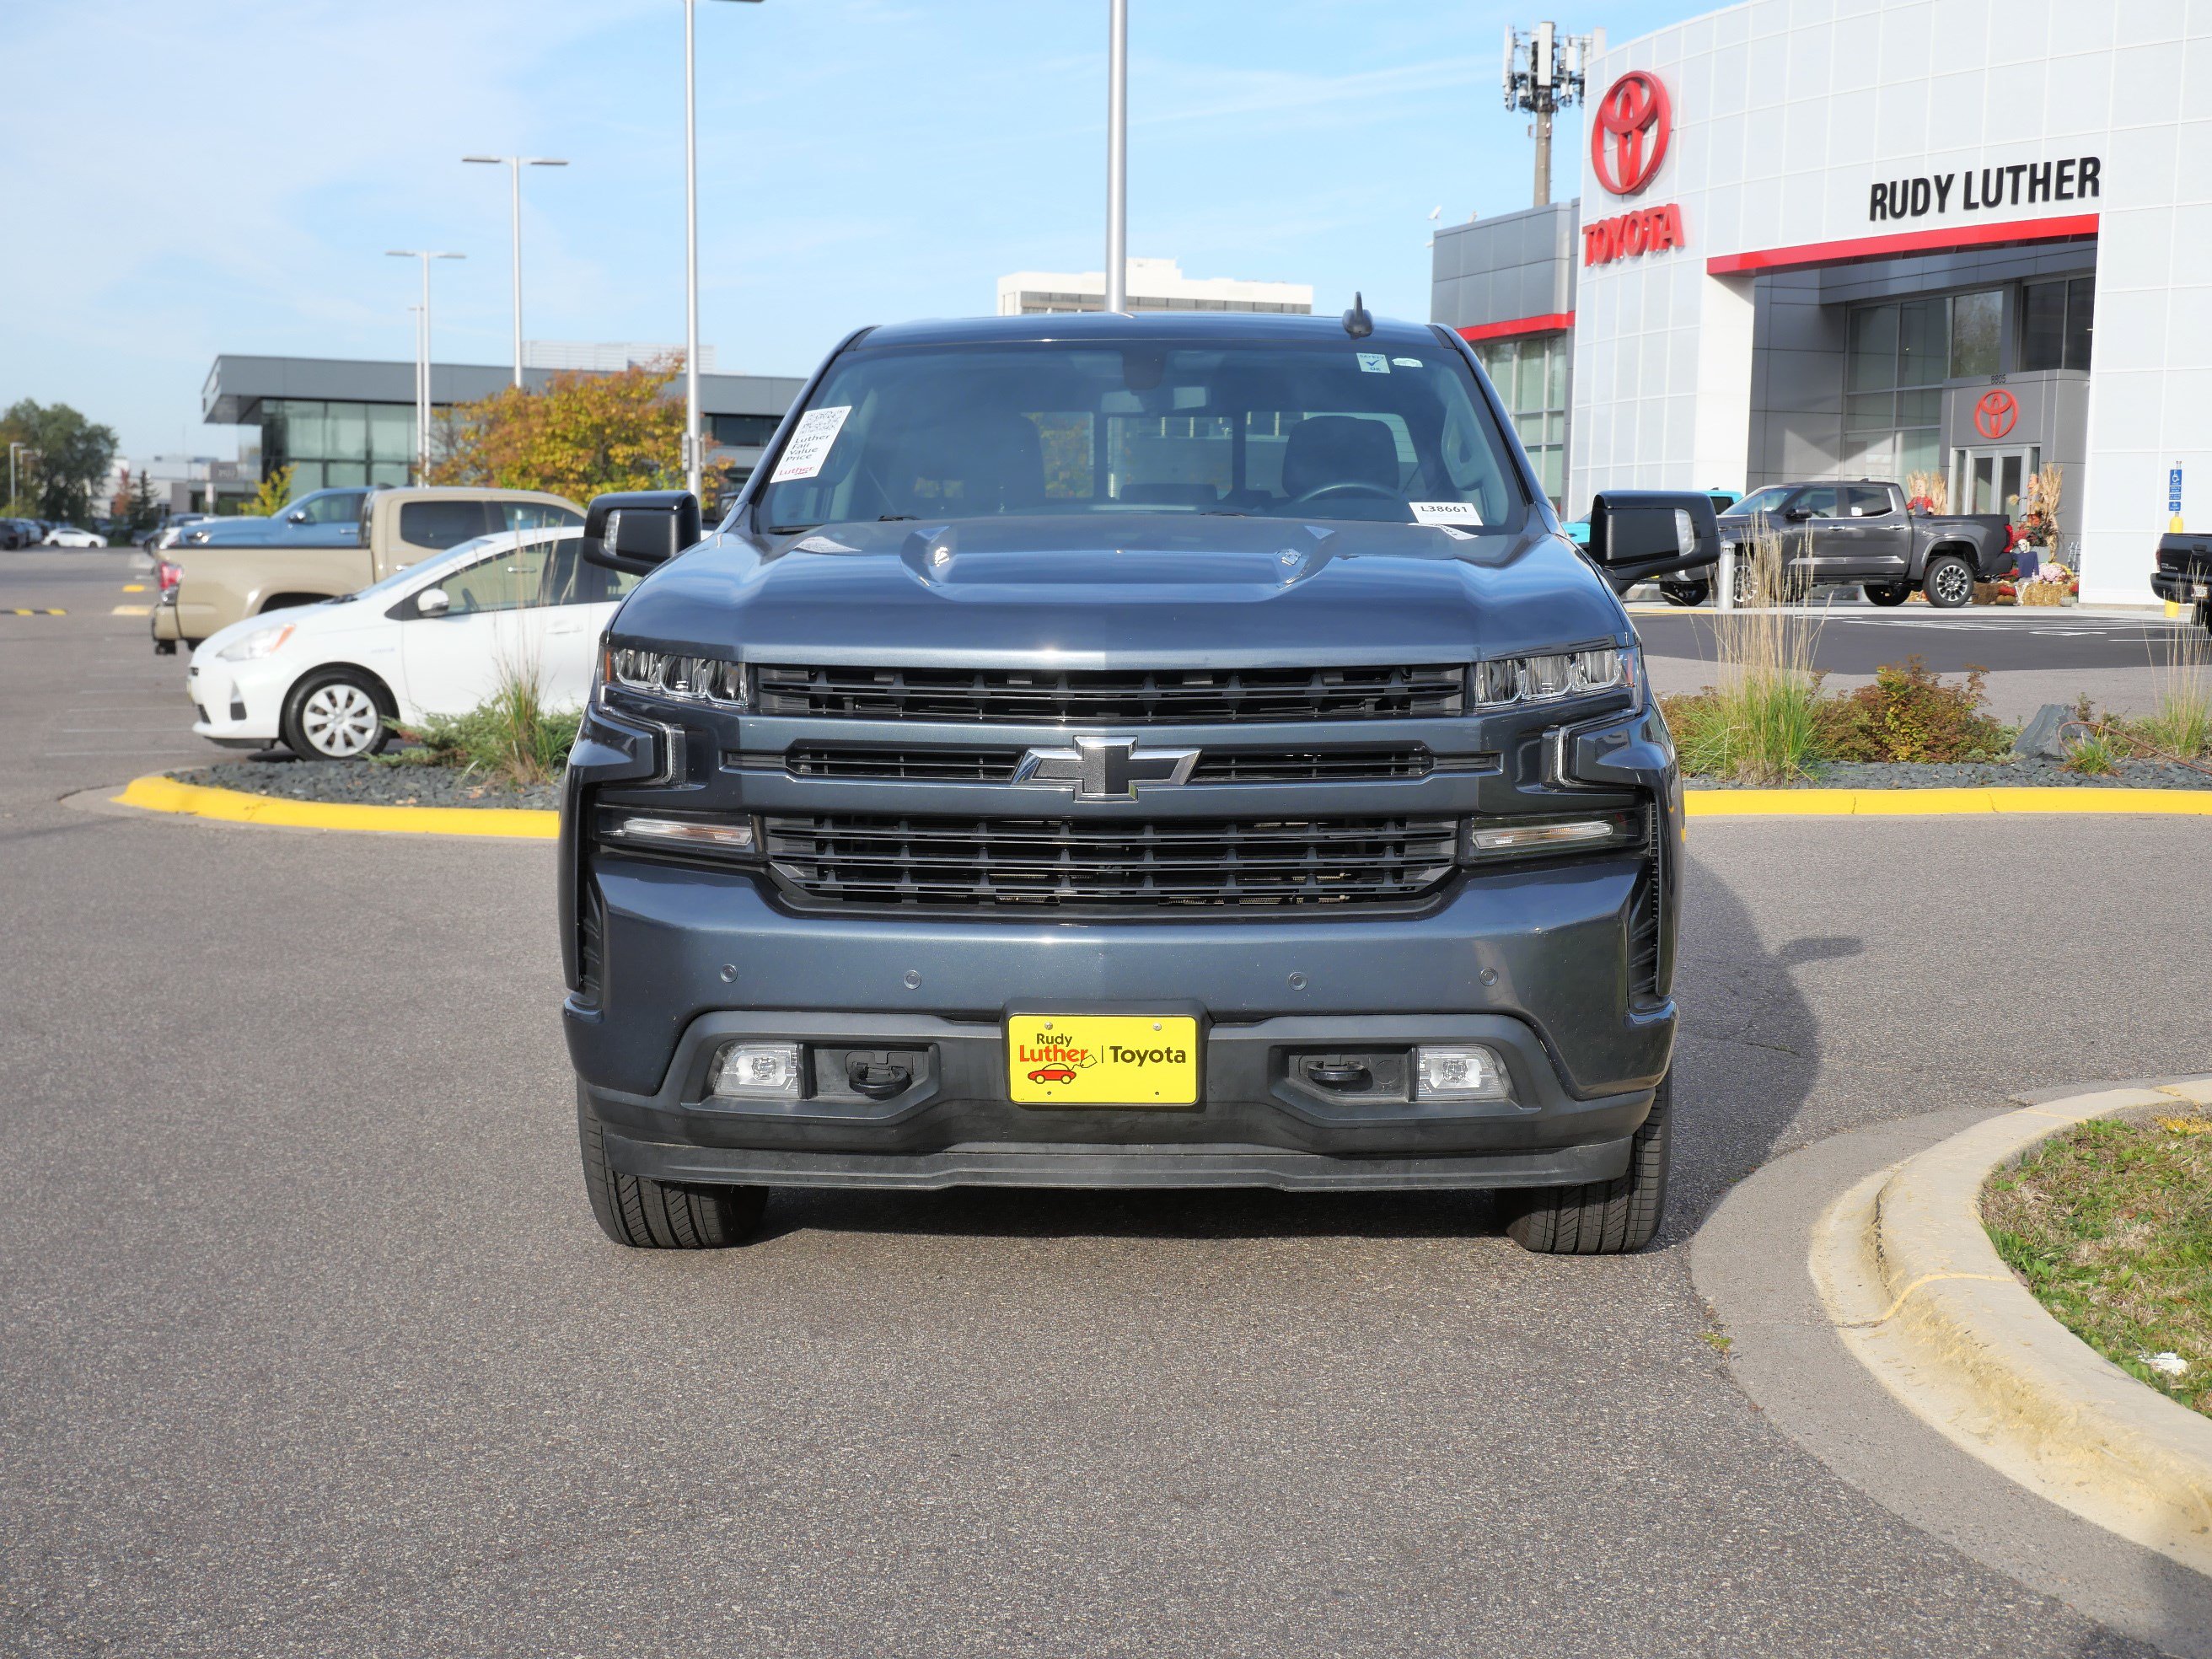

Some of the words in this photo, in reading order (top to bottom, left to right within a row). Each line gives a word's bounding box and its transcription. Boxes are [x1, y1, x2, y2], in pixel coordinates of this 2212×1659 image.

[1870, 174, 1955, 221] RUDY
[1963, 157, 2101, 210] LUTHER
[1582, 203, 1684, 266] TOYOTA
[1019, 1044, 1089, 1062] Luther
[1109, 1045, 1186, 1067] Toyota
[1036, 1033, 1072, 1047] Rudy
